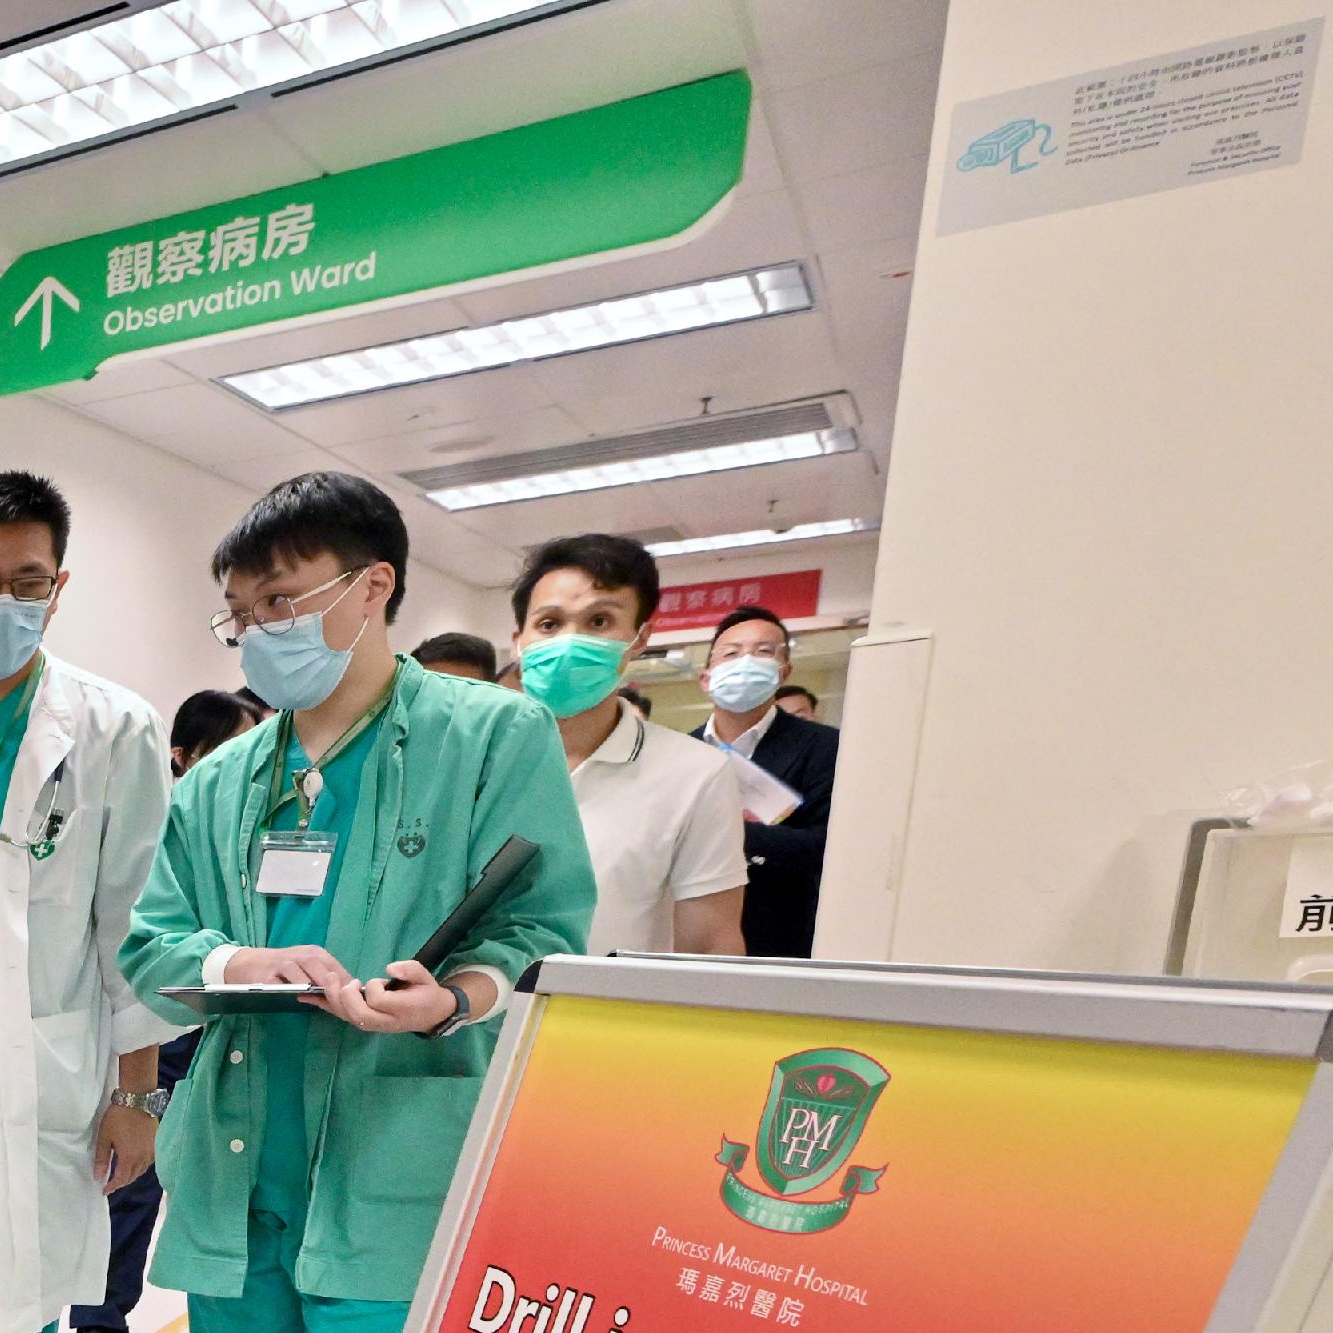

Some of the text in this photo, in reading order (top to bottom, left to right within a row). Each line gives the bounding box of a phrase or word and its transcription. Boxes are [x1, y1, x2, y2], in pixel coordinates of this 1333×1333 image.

[106, 203, 316, 298] 觀察病房
[103, 252, 377, 336] Observation Ward
[676, 1267, 805, 1328] 瑪嘉烈醫院
